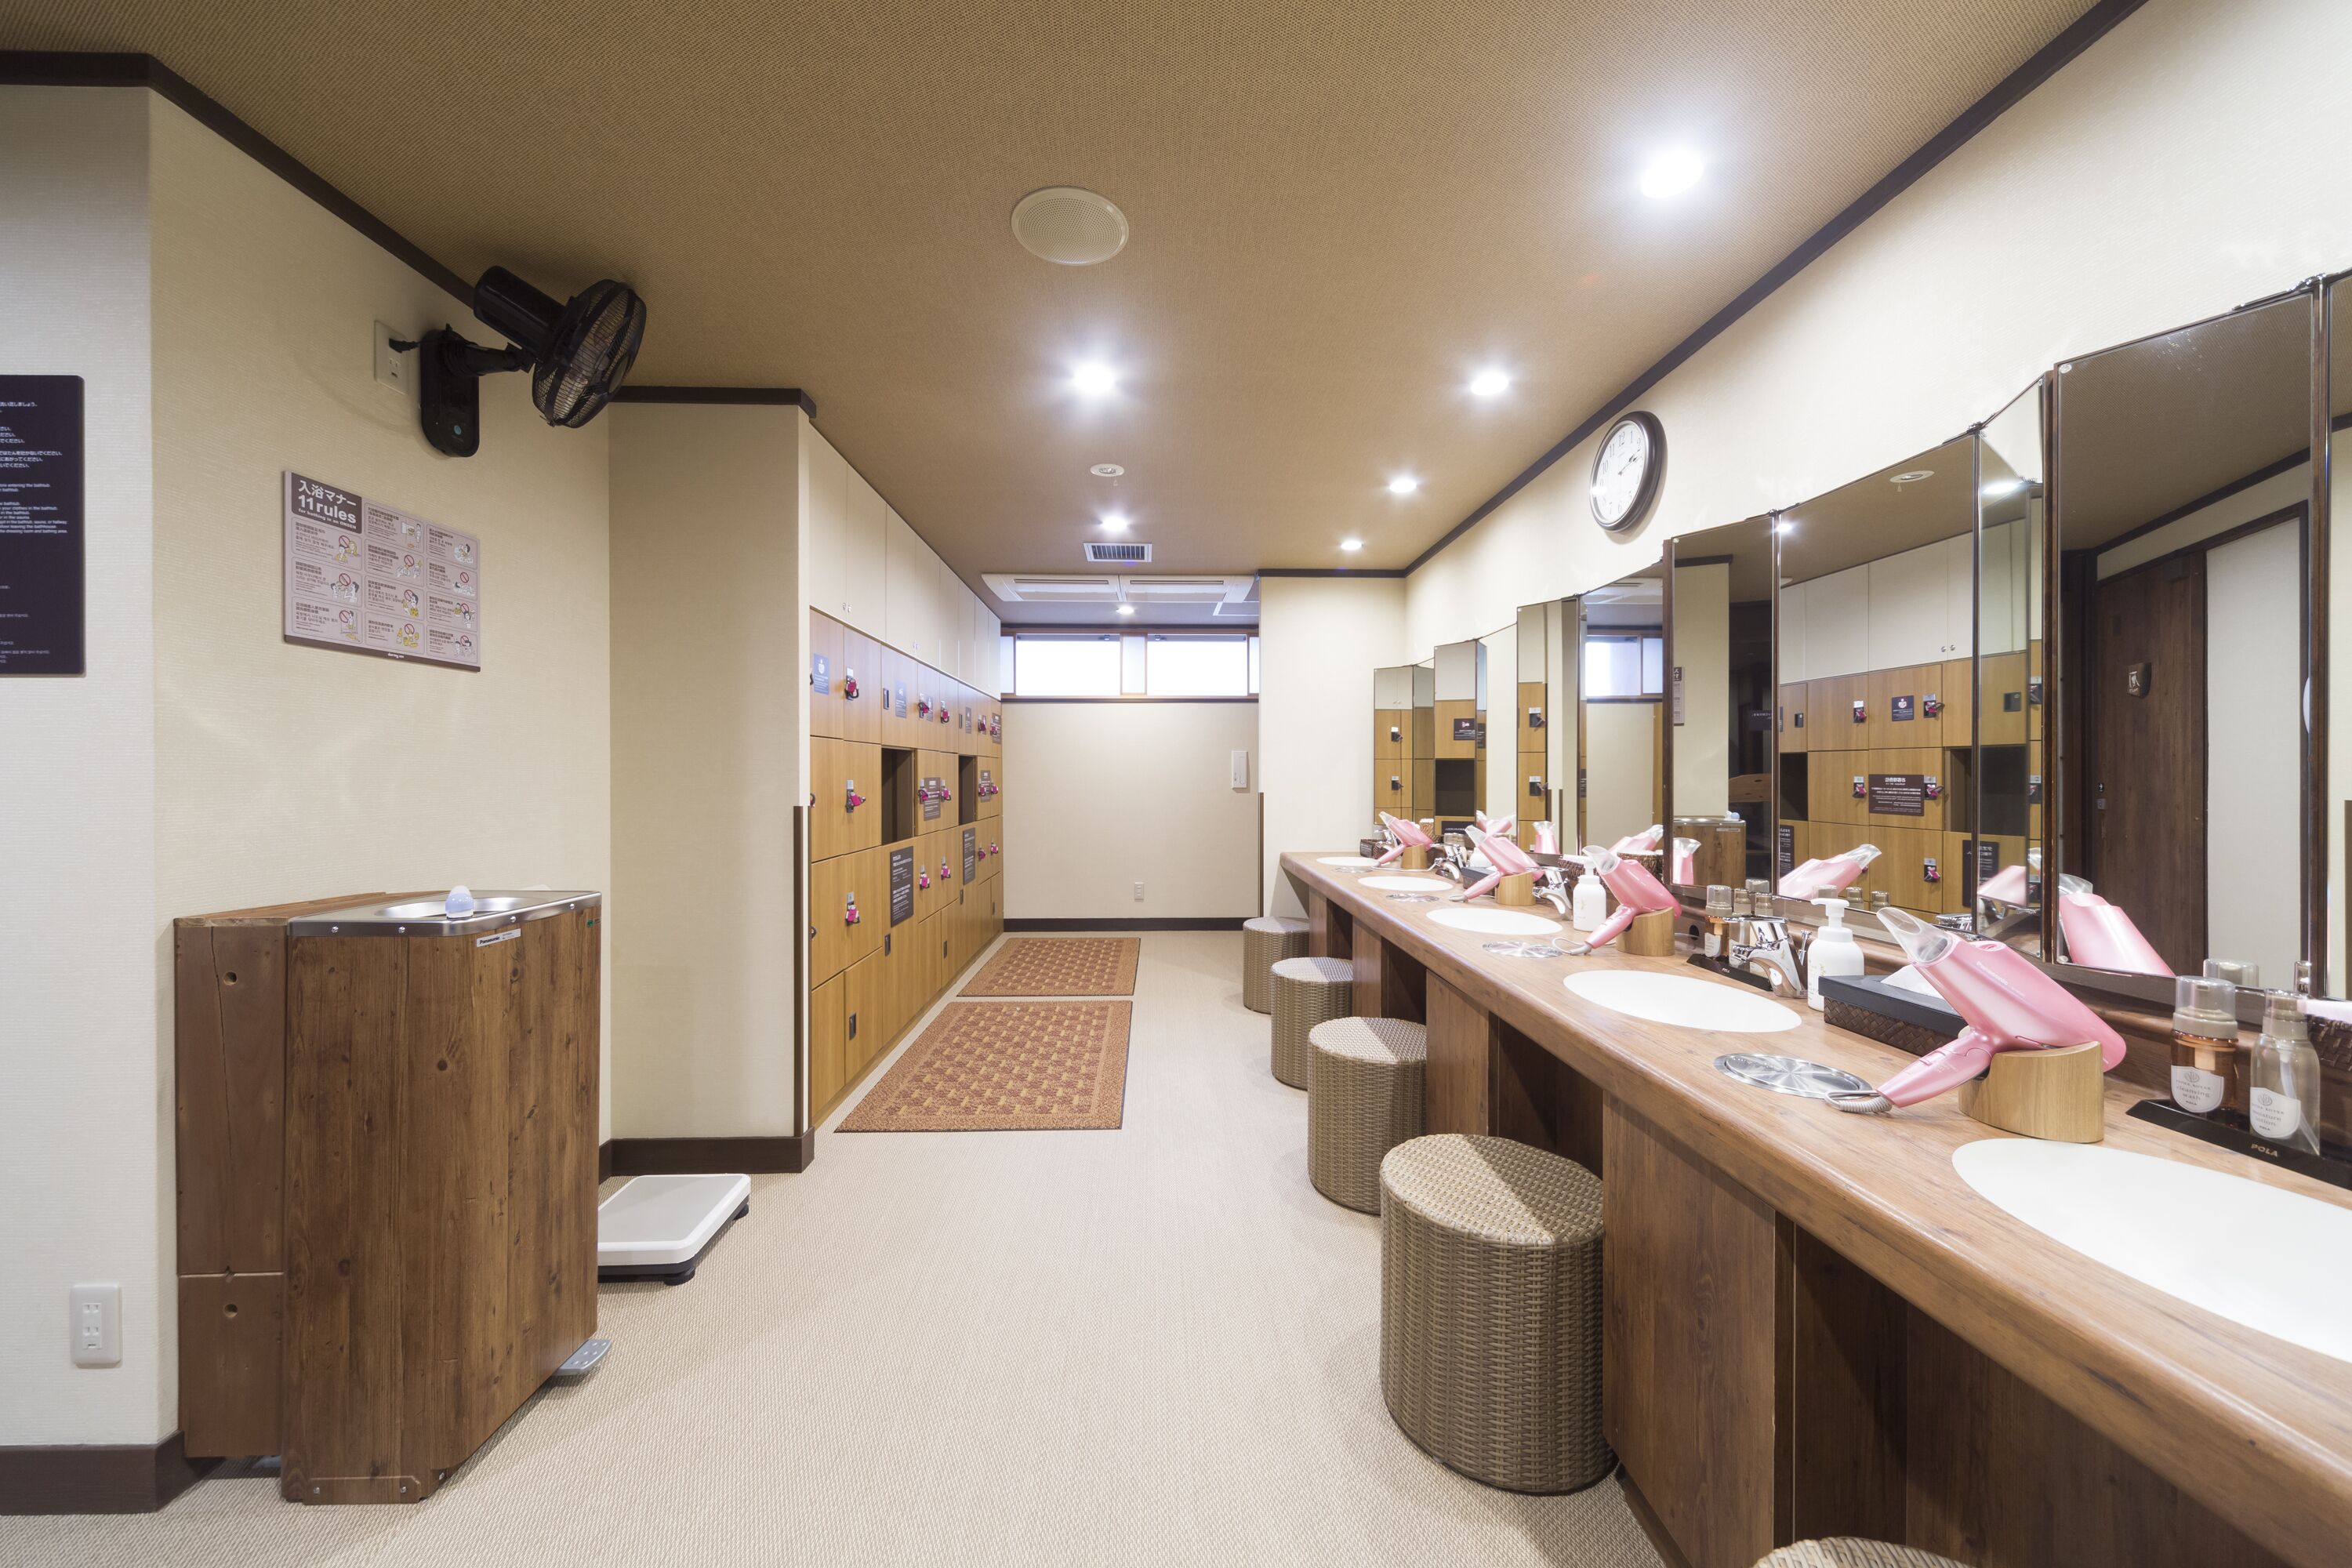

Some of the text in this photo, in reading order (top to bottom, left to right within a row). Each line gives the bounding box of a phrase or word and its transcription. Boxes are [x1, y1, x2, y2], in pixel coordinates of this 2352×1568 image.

[298, 480, 357, 506] 入浴マナー
[2176, 1086, 2210, 1098] cleansing
[2251, 1144, 2278, 1157] POLA
